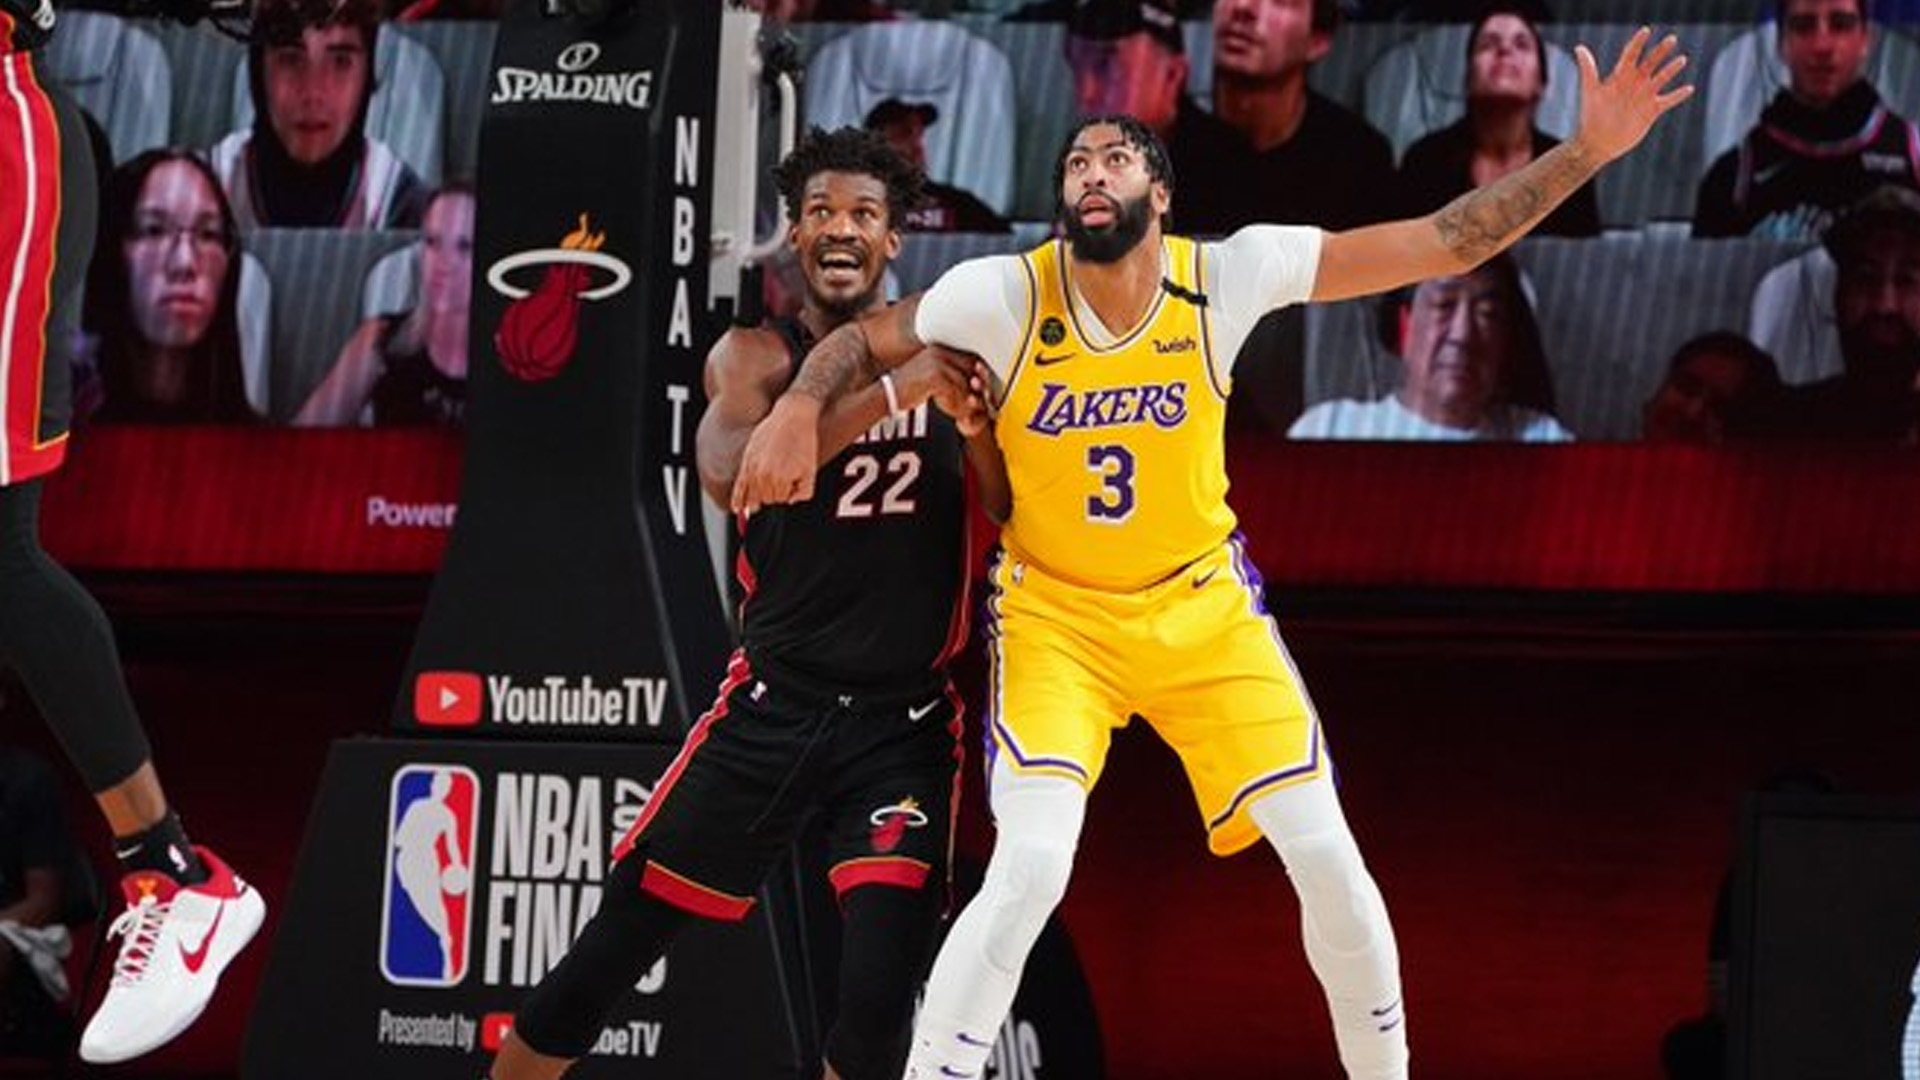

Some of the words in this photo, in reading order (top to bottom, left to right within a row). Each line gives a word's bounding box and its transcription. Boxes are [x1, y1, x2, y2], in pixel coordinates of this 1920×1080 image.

[491, 67, 652, 108] SPALDING
[667, 115, 700, 348] NBA
[1025, 381, 1189, 438] LAKERS
[663, 384, 689, 535] TV
[836, 451, 922, 518] 22
[1085, 443, 1137, 524] 3
[367, 497, 458, 528] Power
[491, 773, 603, 881] NBA
[378, 1009, 456, 1045] Presented
[459, 1014, 477, 1052] by
